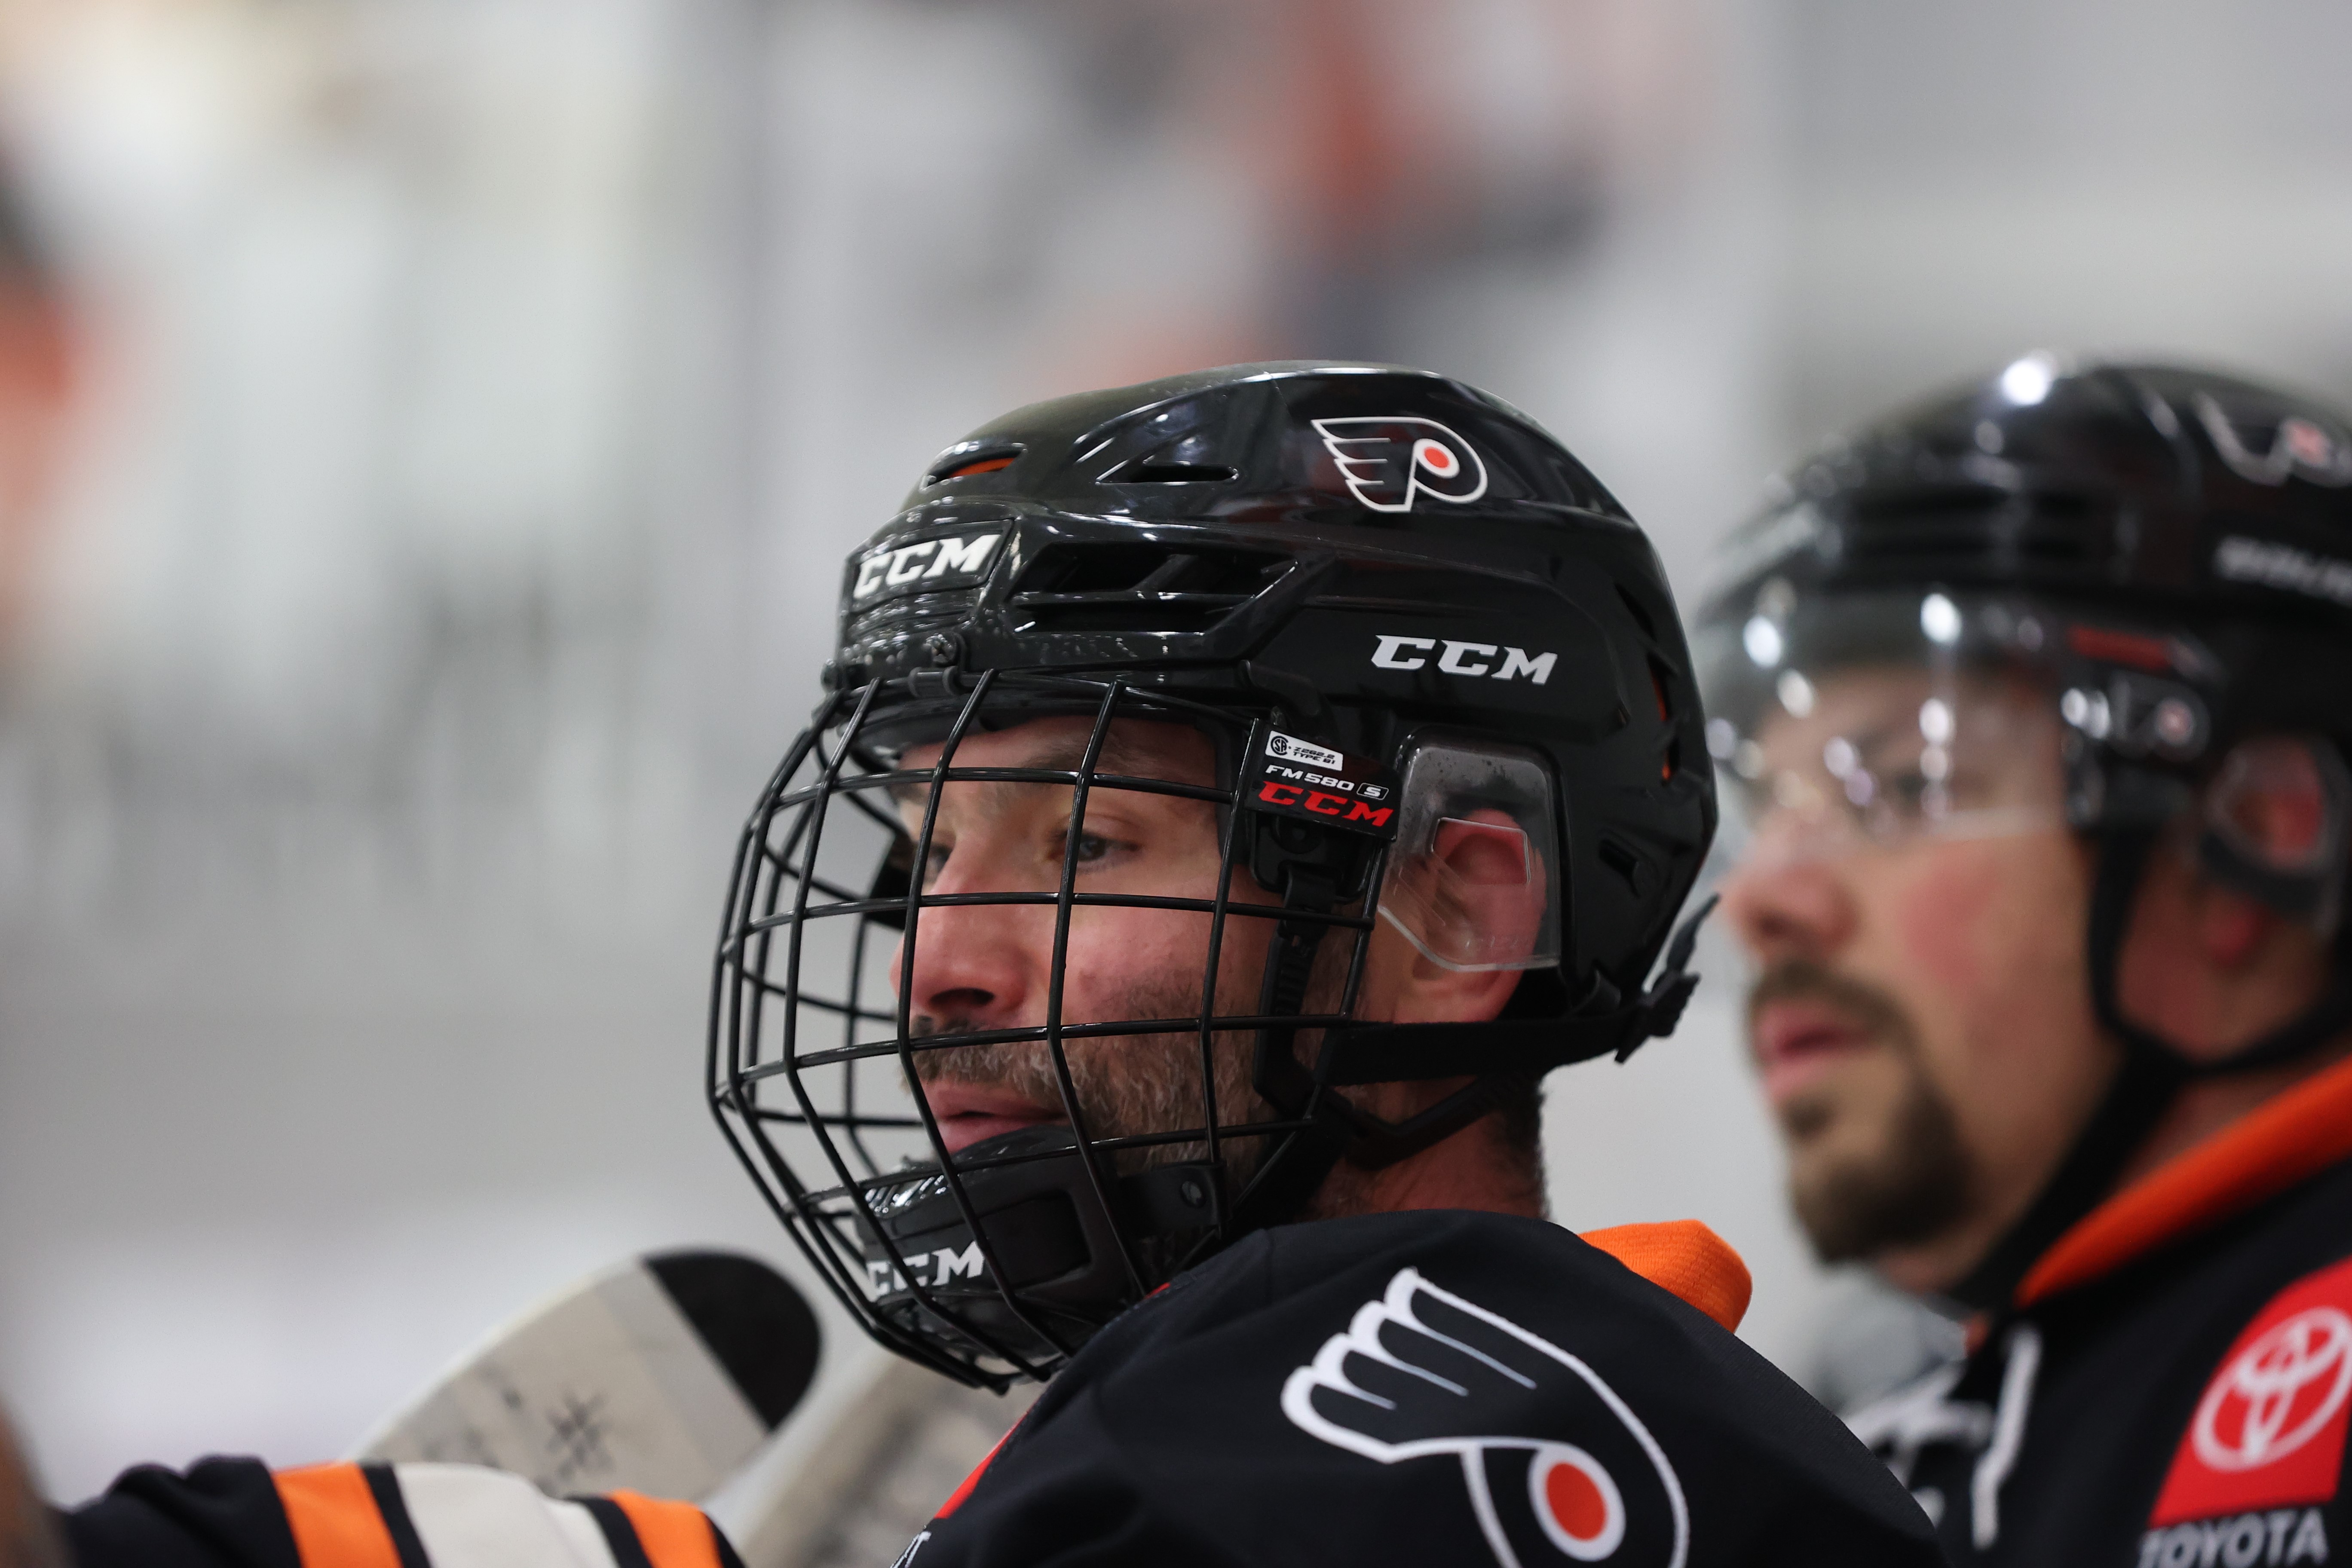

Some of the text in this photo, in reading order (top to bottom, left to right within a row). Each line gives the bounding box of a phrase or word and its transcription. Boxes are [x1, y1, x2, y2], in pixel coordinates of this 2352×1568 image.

[853, 534, 1001, 599] CCM
[1371, 635, 1558, 686] CCM
[1293, 751, 1321, 761] TYPE
[1258, 781, 1394, 827] CCM
[1363, 786, 1381, 797] S
[2138, 1507, 2330, 1568] TOYOTA
